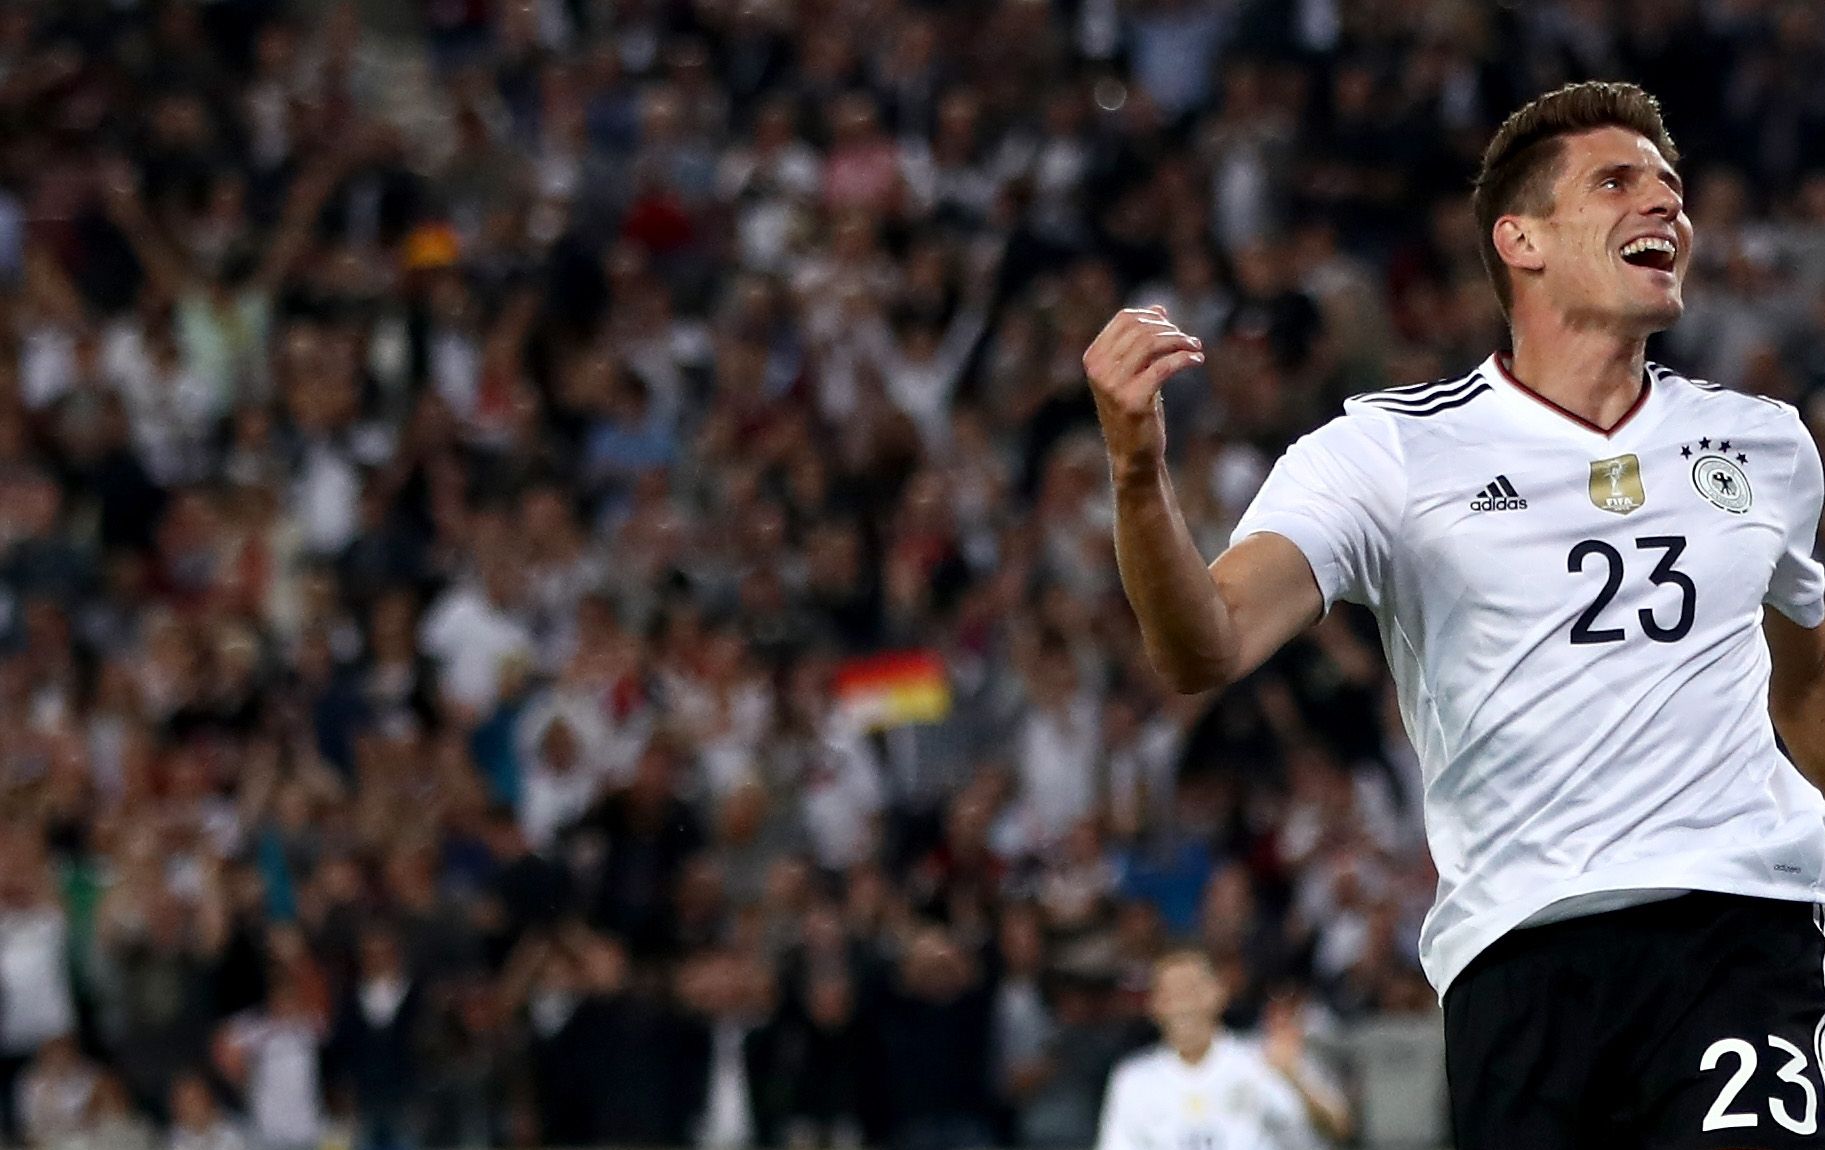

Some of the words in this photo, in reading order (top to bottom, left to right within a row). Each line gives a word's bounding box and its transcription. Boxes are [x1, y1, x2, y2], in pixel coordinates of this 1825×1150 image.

[1470, 497, 1528, 511] adidas
[1567, 535, 1697, 645] 23
[1700, 1034, 1818, 1136] 23
